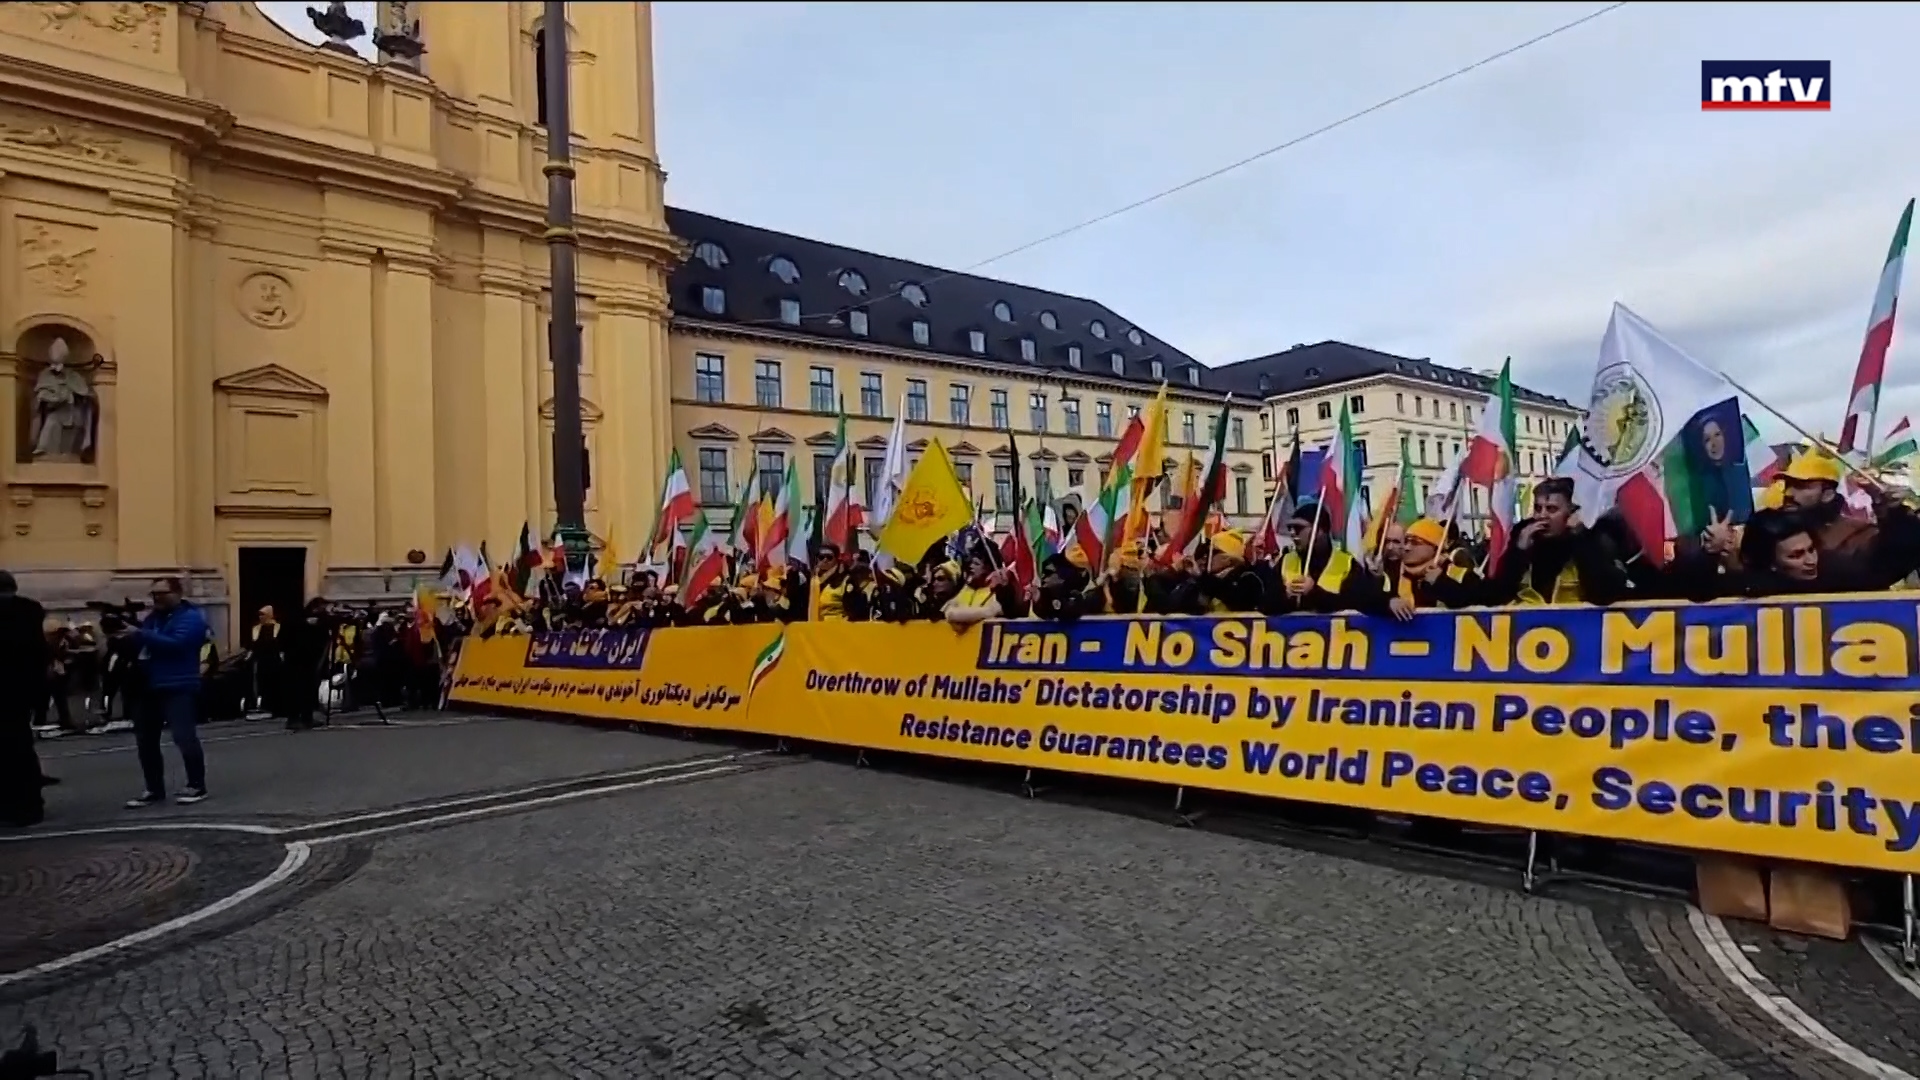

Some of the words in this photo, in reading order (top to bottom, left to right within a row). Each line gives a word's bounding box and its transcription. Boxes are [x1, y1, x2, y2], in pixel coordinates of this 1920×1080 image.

[607, 631, 646, 664] ایران
[987, 625, 1067, 664] Iran
[1123, 620, 1194, 667] No
[1210, 618, 1369, 670] Shah
[1453, 615, 1570, 673] No
[1600, 606, 1920, 678] Mulla
[605, 679, 641, 702] آخوندی
[640, 682, 692, 706] دیکتاتوری
[693, 683, 741, 711] سرنگونی
[806, 669, 900, 696] Overthrow
[905, 673, 928, 698] of
[1035, 678, 1236, 724] Dictatorship
[1247, 686, 1297, 729] by
[1307, 689, 1475, 730] Iranian
[1492, 694, 1737, 751] People,
[900, 713, 1032, 749] Resistance
[1039, 725, 1228, 770] Guarantees
[1241, 740, 1368, 785] World
[1381, 751, 1569, 810] Peace,
[1592, 766, 1920, 851] Security
